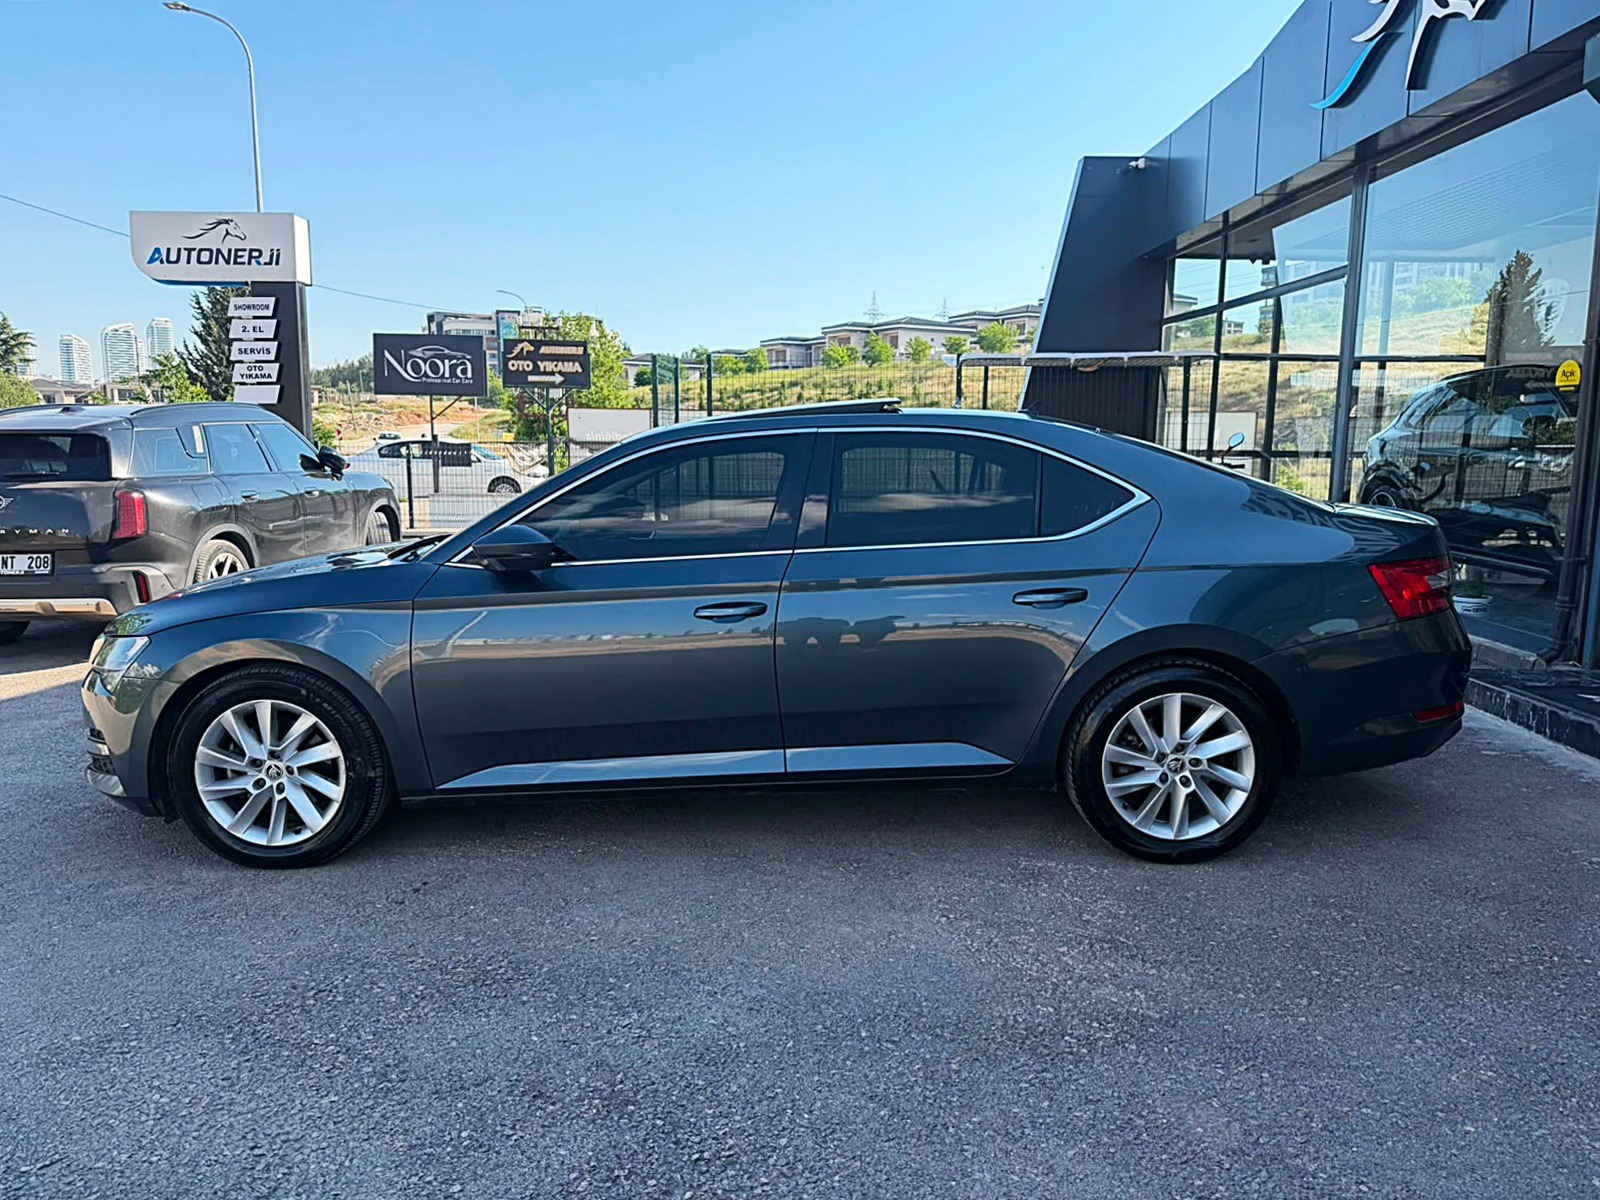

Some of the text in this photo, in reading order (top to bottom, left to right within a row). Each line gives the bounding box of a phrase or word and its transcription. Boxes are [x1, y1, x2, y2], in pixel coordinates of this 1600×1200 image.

[233, 303, 270, 311] SHOWROOM
[241, 325, 264, 333] 2. EL
[237, 346, 271, 355] SERVİS
[383, 349, 472, 382] Noora
[507, 359, 583, 373] OTO YIKAMA
[1, 555, 50, 569] NT 208
